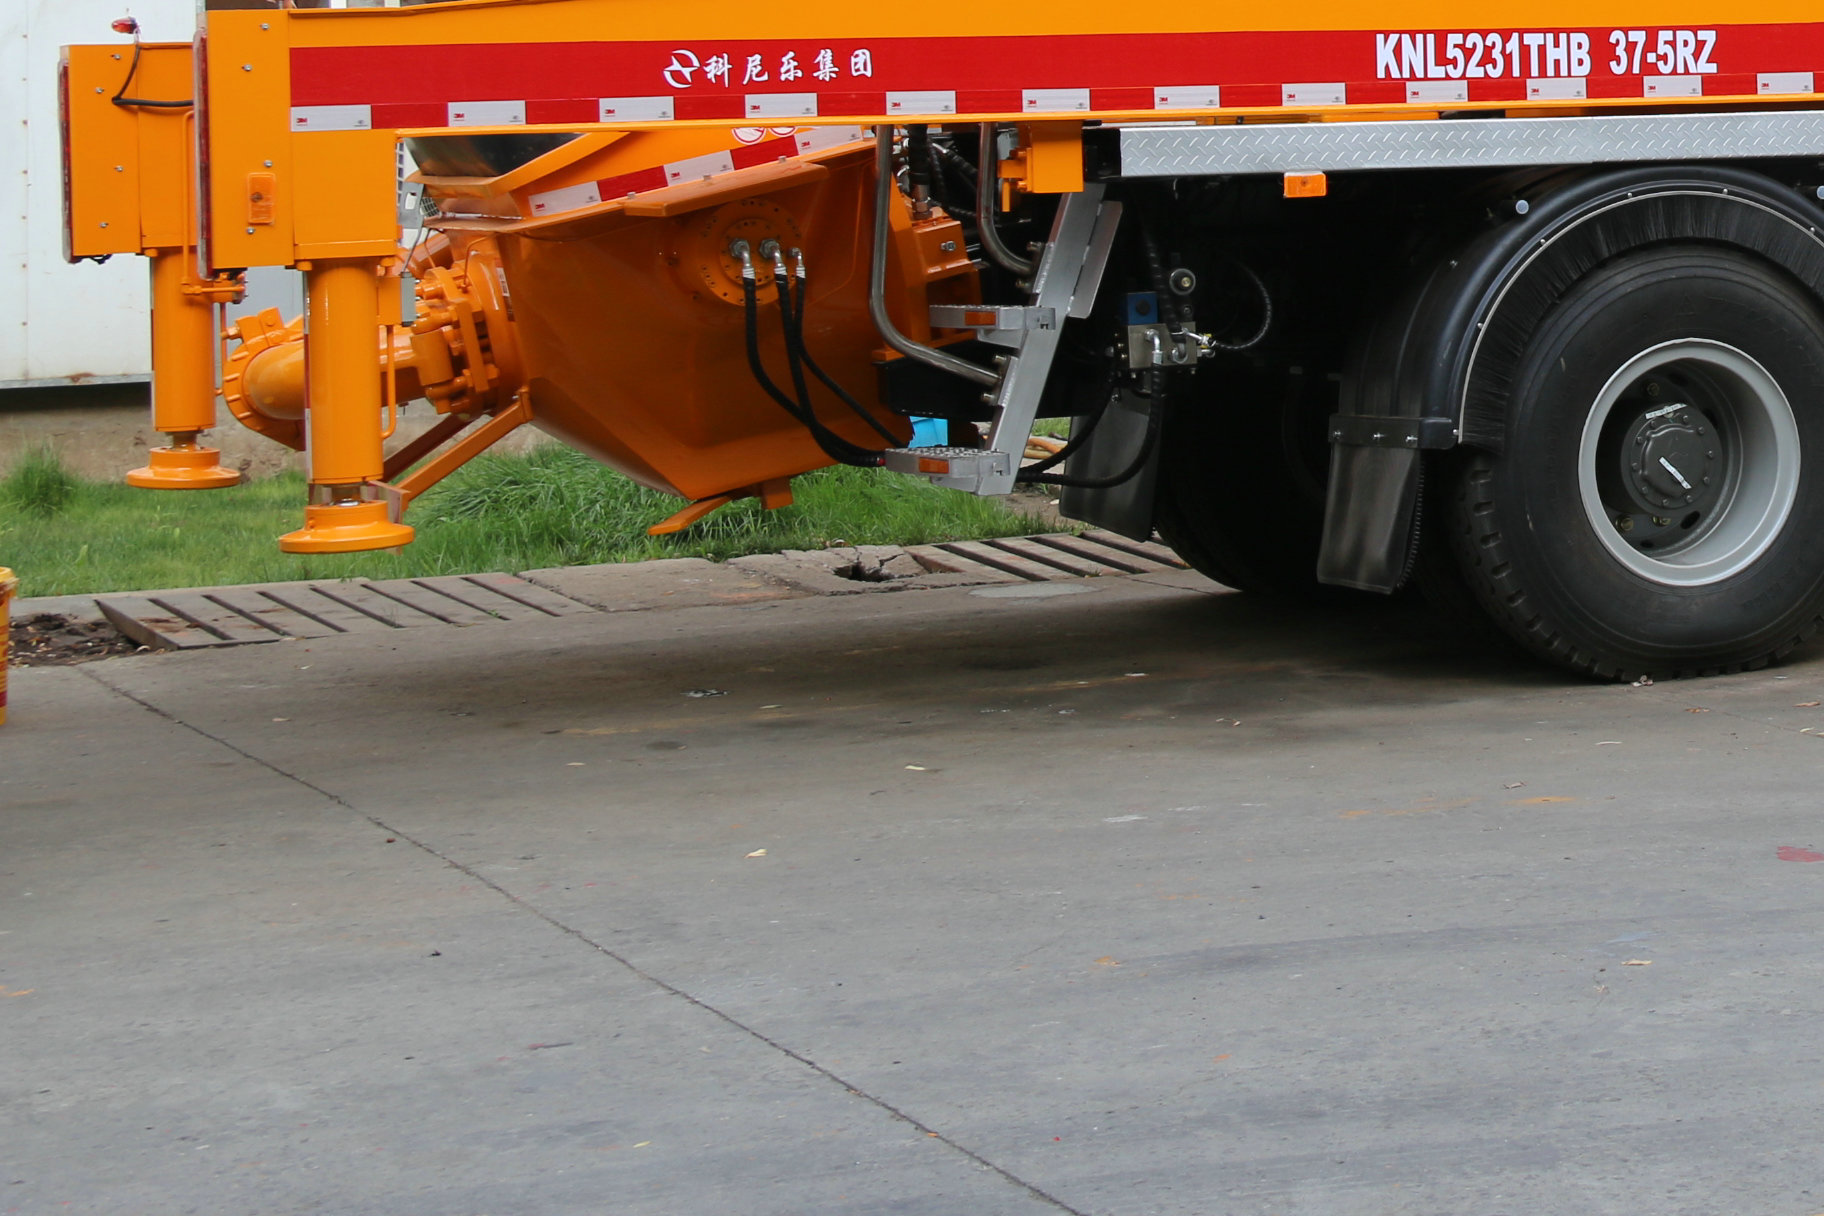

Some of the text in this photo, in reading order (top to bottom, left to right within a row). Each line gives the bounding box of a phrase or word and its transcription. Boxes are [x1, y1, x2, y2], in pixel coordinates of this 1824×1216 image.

[703, 48, 873, 88] 科尼乐集团
[1377, 30, 1718, 79] KNL5231THB 37-5RZ
